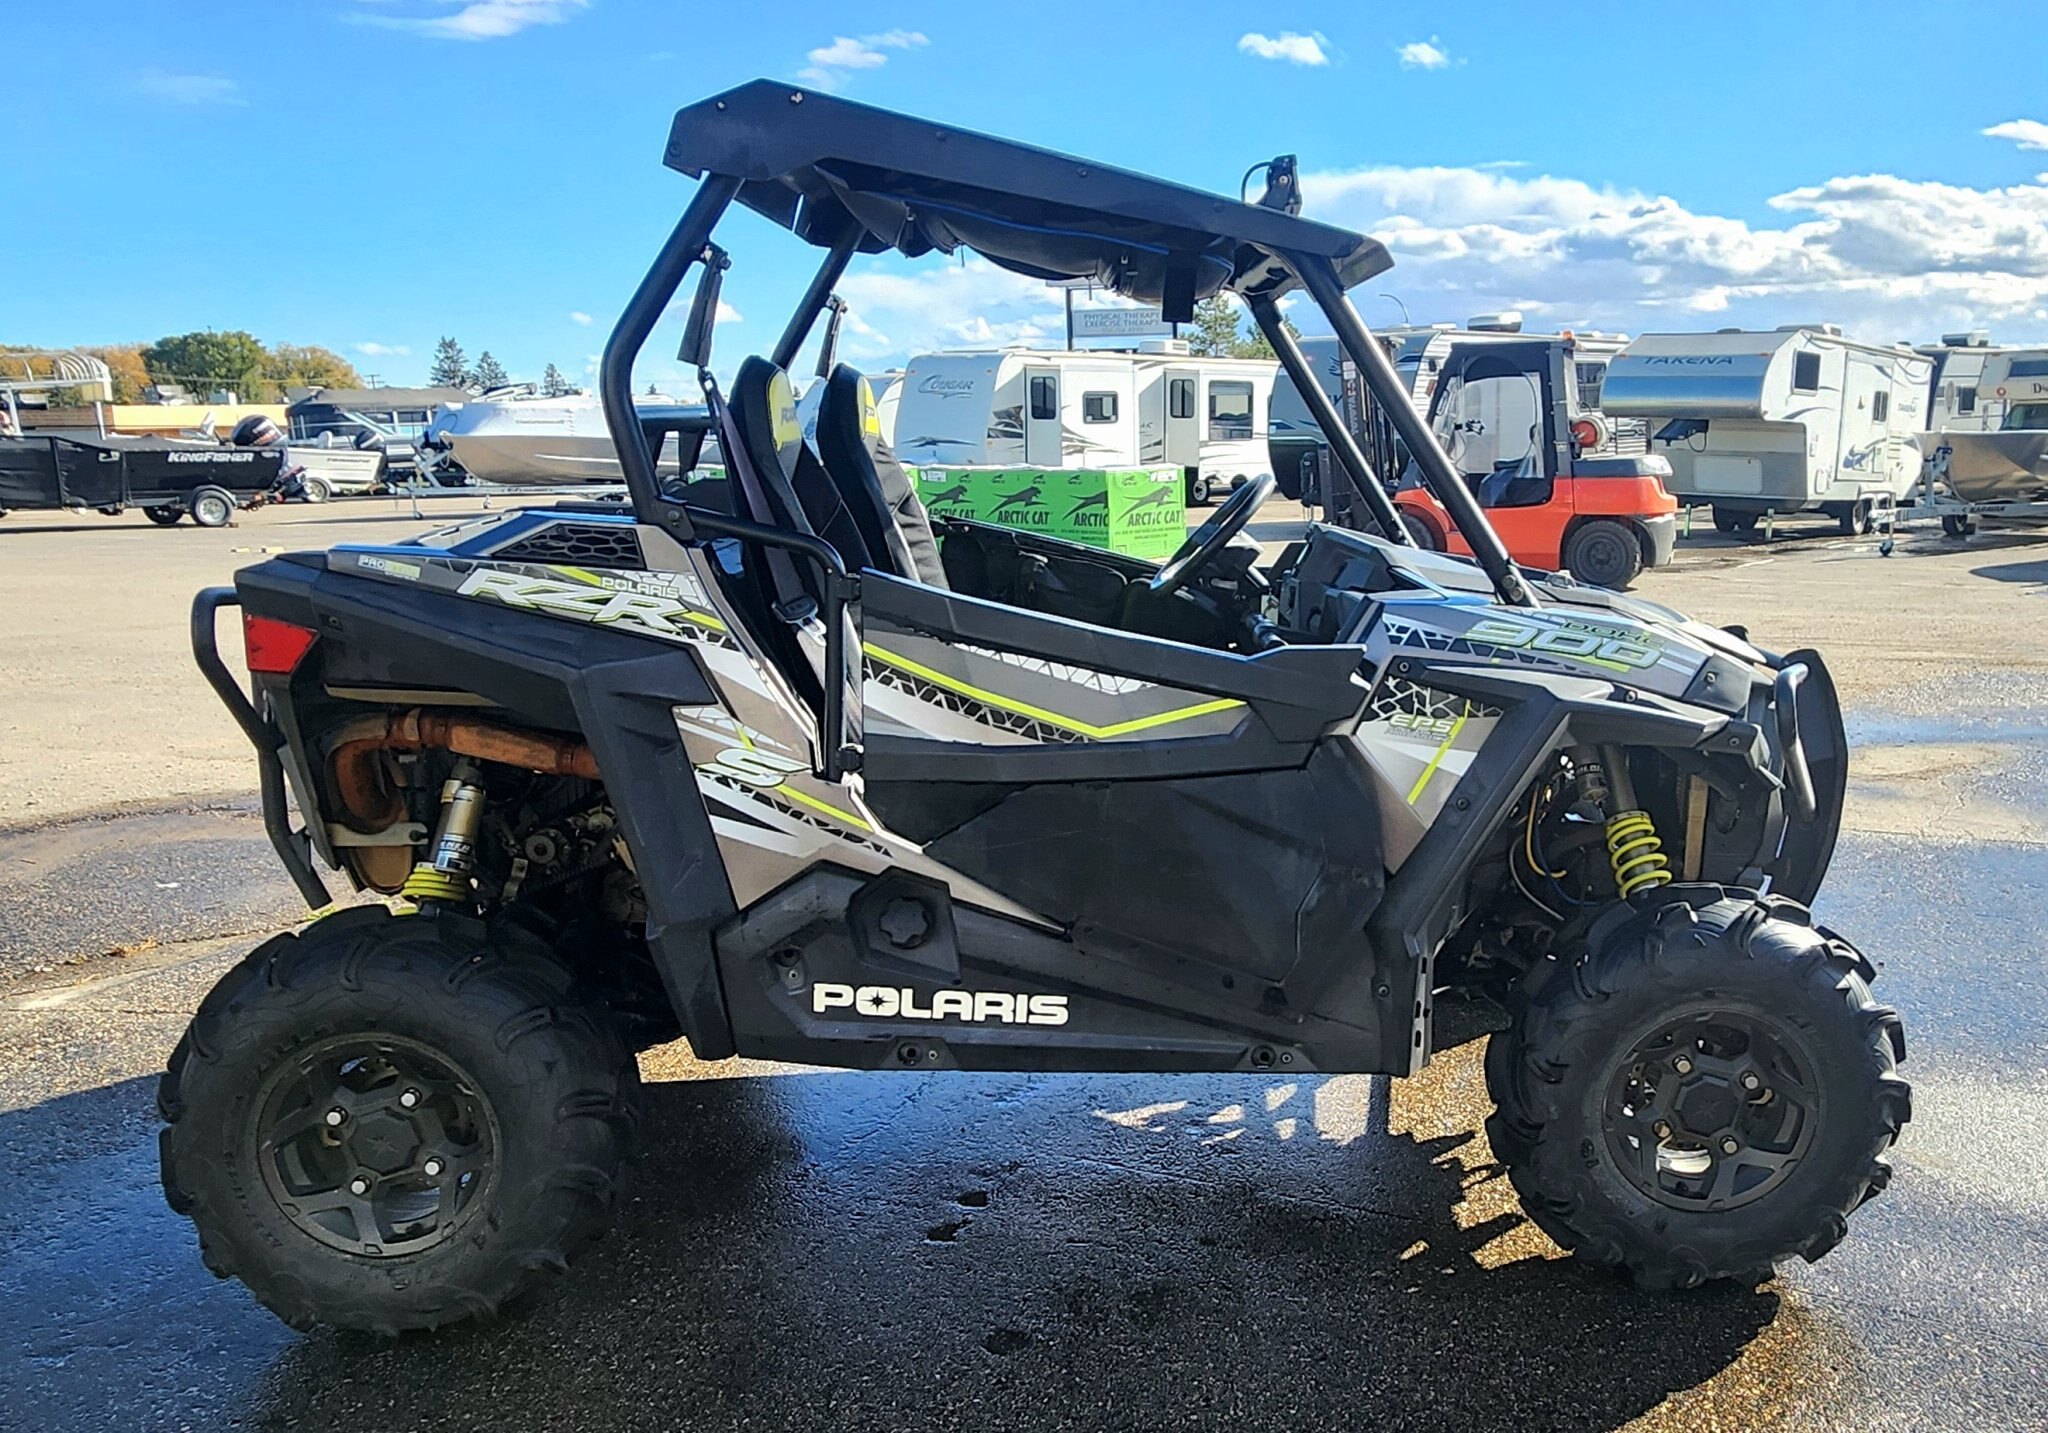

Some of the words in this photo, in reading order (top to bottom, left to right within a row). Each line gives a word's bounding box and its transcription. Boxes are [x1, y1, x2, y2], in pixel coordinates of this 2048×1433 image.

[1084, 320, 1121, 328] EXERCISE
[1124, 319, 1160, 327] THERAPY
[1124, 311, 1160, 319] THERAPY
[1645, 356, 1732, 365] TAKENA
[960, 508, 976, 520] CAT
[997, 510, 1029, 525] ARCTIC
[1032, 511, 1050, 525] CAT
[1073, 512, 1109, 527] ARCTIC
[1127, 511, 1162, 528] ARCTIC
[1164, 509, 1181, 524] CAT
[601, 576, 681, 599] POLARIS
[456, 568, 690, 633] RZR
[1562, 618, 1666, 648] DOHC
[1461, 619, 1662, 669] 900
[1389, 713, 1456, 734] EPS
[813, 983, 1069, 1025] POLARIS
